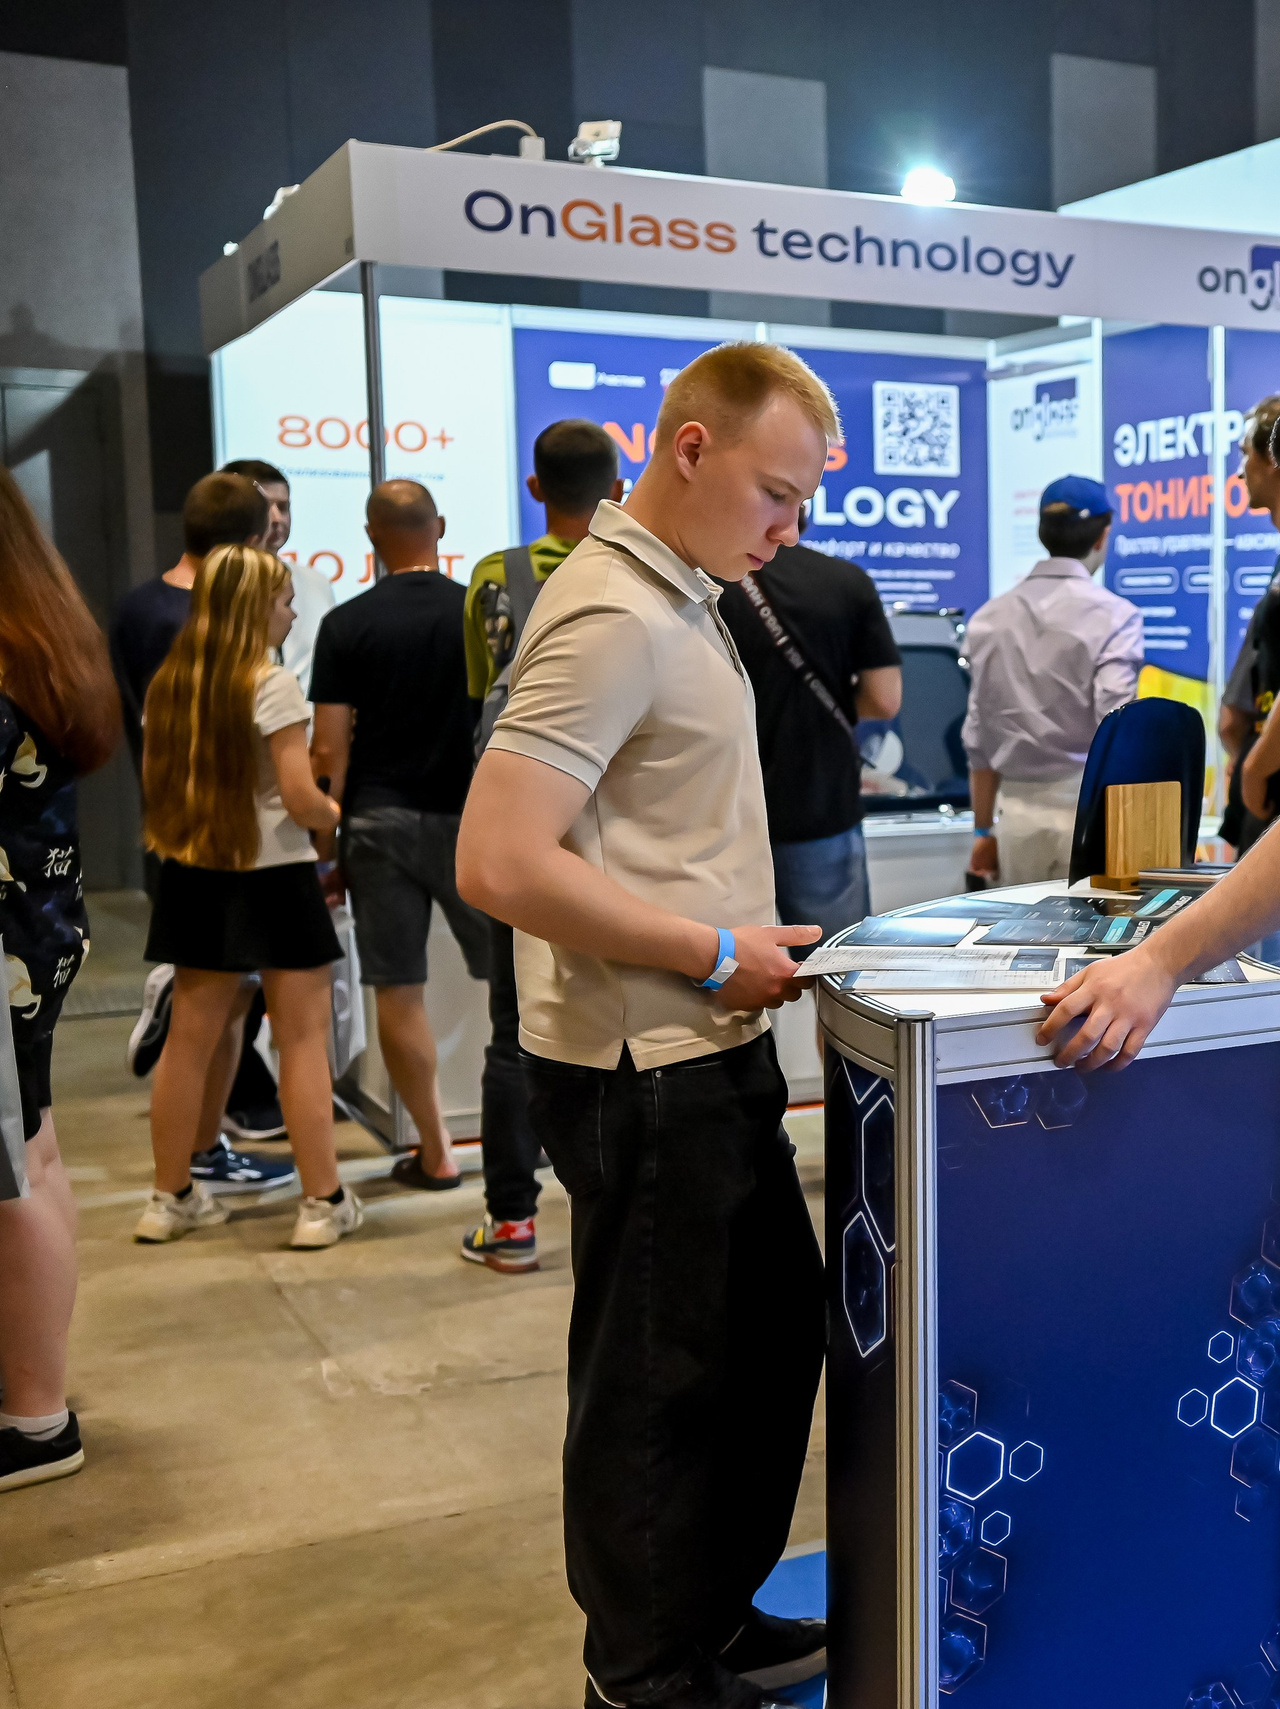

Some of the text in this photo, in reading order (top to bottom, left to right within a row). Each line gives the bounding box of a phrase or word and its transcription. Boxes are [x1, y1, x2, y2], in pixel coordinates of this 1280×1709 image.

[464, 189, 1075, 289] OnGlass technology
[1113, 410, 1250, 468] ЭЛЕКТР
[1114, 474, 1271, 523] ТОНИРО
